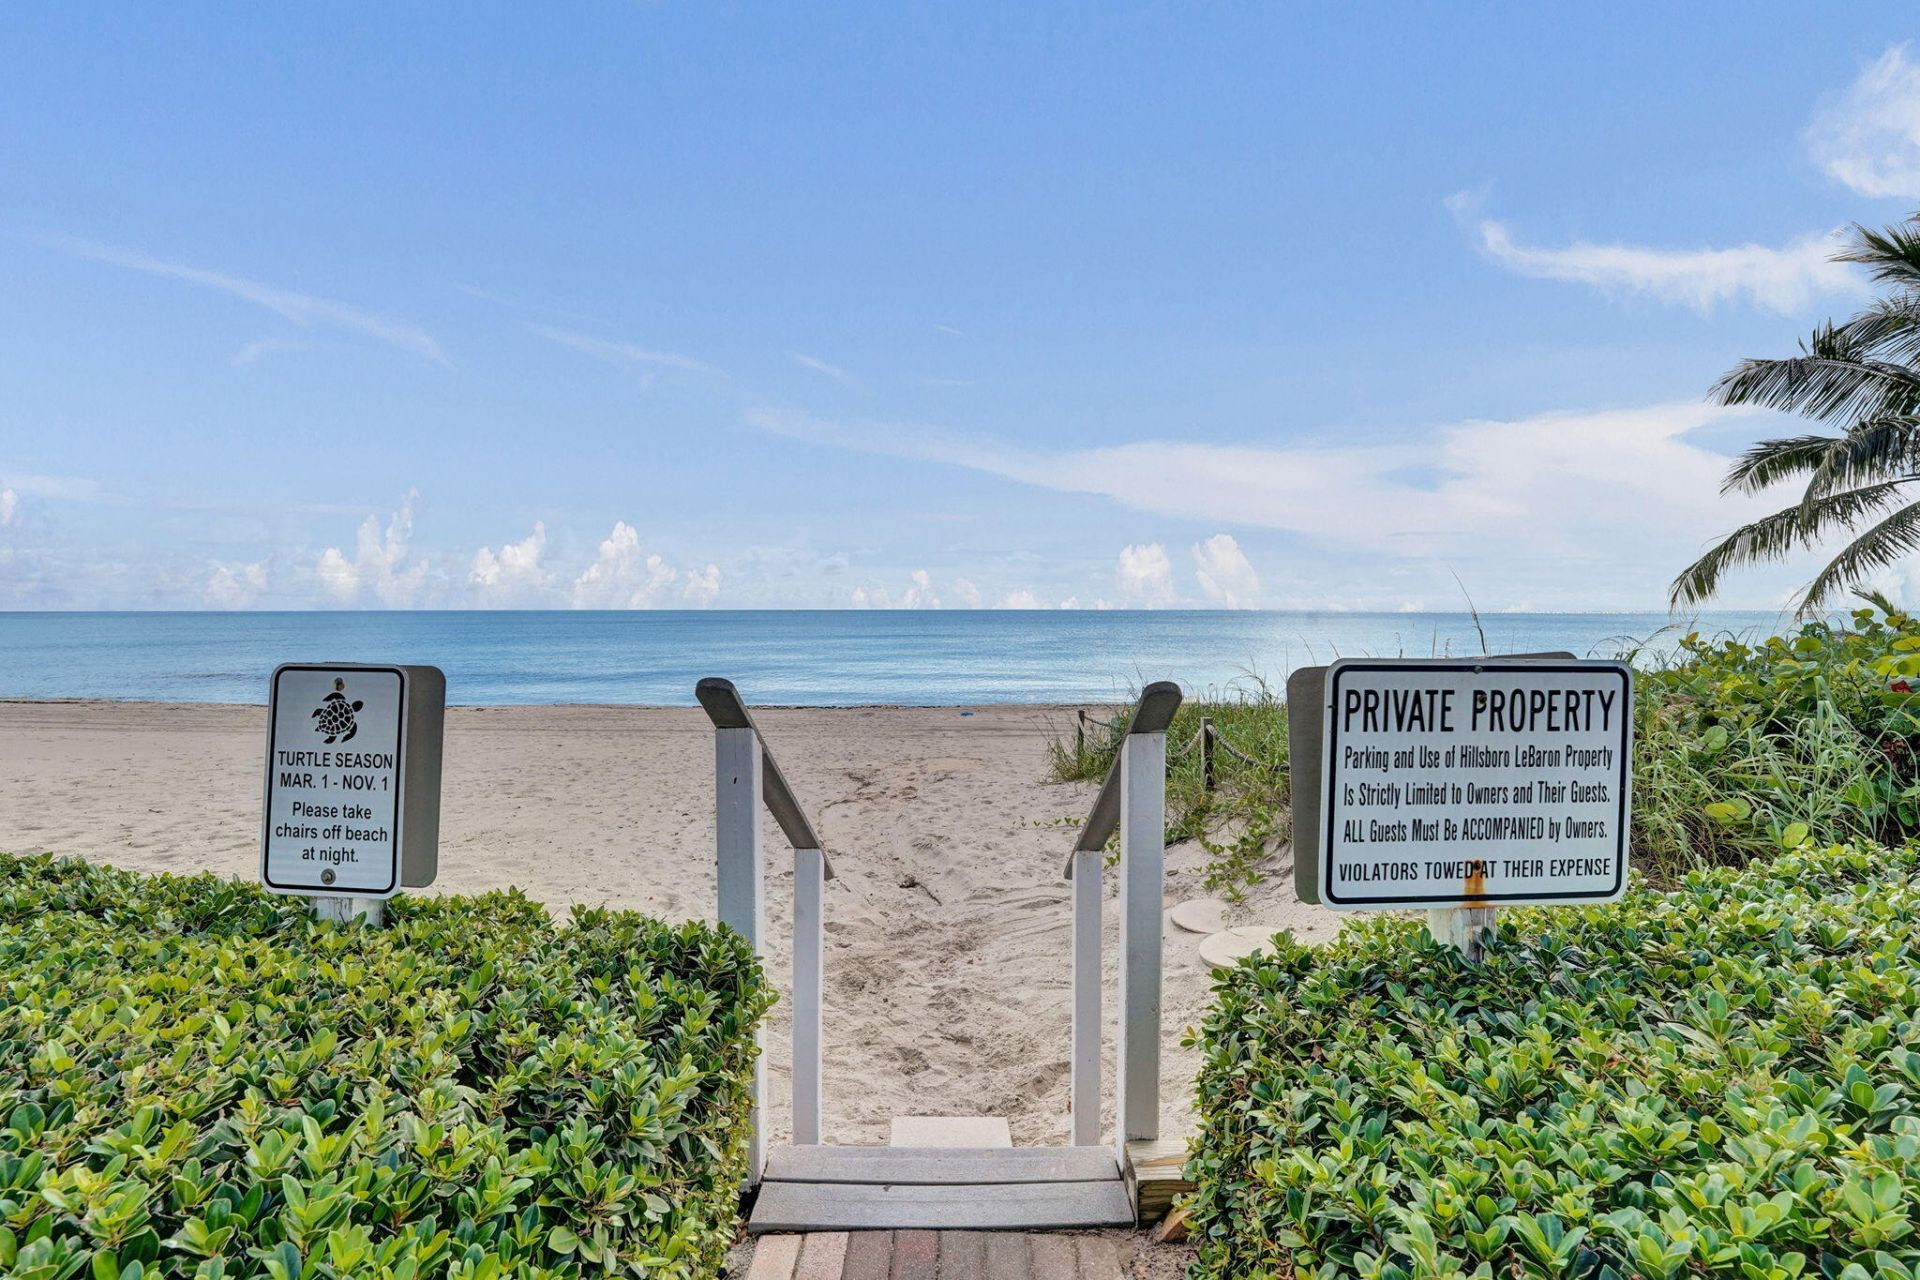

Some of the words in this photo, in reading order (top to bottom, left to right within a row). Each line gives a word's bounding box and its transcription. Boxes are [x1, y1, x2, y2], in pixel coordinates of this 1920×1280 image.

[1344, 690, 1455, 732] PRIVATE
[1472, 689, 1615, 732] PROPERTY
[278, 751, 331, 767] TURTLE
[335, 753, 392, 769] SEASON
[1344, 746, 1389, 772] Parking
[1394, 746, 1414, 769] and
[1420, 746, 1439, 768] Use
[1445, 745, 1455, 768] of
[1460, 745, 1510, 768] Hillsboro
[1515, 745, 1560, 768] LeBaron
[1566, 745, 1612, 771] Property
[280, 773, 316, 788] MAR.
[322, 774, 327, 788] 1
[343, 775, 376, 790] NOV.
[382, 776, 387, 791] 1
[1344, 783, 1354, 806] Is
[1359, 782, 1401, 809] Strictly
[1405, 782, 1447, 805] Limited
[1451, 784, 1461, 804] to
[1467, 782, 1508, 804] Owners
[1513, 781, 1533, 804] and
[1538, 781, 1566, 803] Their
[1571, 780, 1610, 803] Guests.
[293, 802, 338, 818] Please
[343, 804, 371, 819] take
[276, 823, 317, 838] chairs
[323, 825, 341, 839] off
[346, 826, 387, 841] beach
[1344, 819, 1364, 842] ALL
[1370, 819, 1407, 842] Guests
[1412, 819, 1439, 841] Must
[1444, 818, 1457, 841] Be
[1462, 817, 1544, 840] ACCOMPANIED
[1549, 817, 1561, 842] by
[1566, 817, 1607, 839] Owners.
[302, 846, 315, 860] at
[320, 846, 358, 865] night.
[1340, 862, 1418, 881] VIOLATORS
[1425, 860, 1474, 880] TOWED
[1480, 860, 1497, 878] AT
[1503, 860, 1543, 878] THEIR
[1550, 858, 1610, 877] EXPENSE
